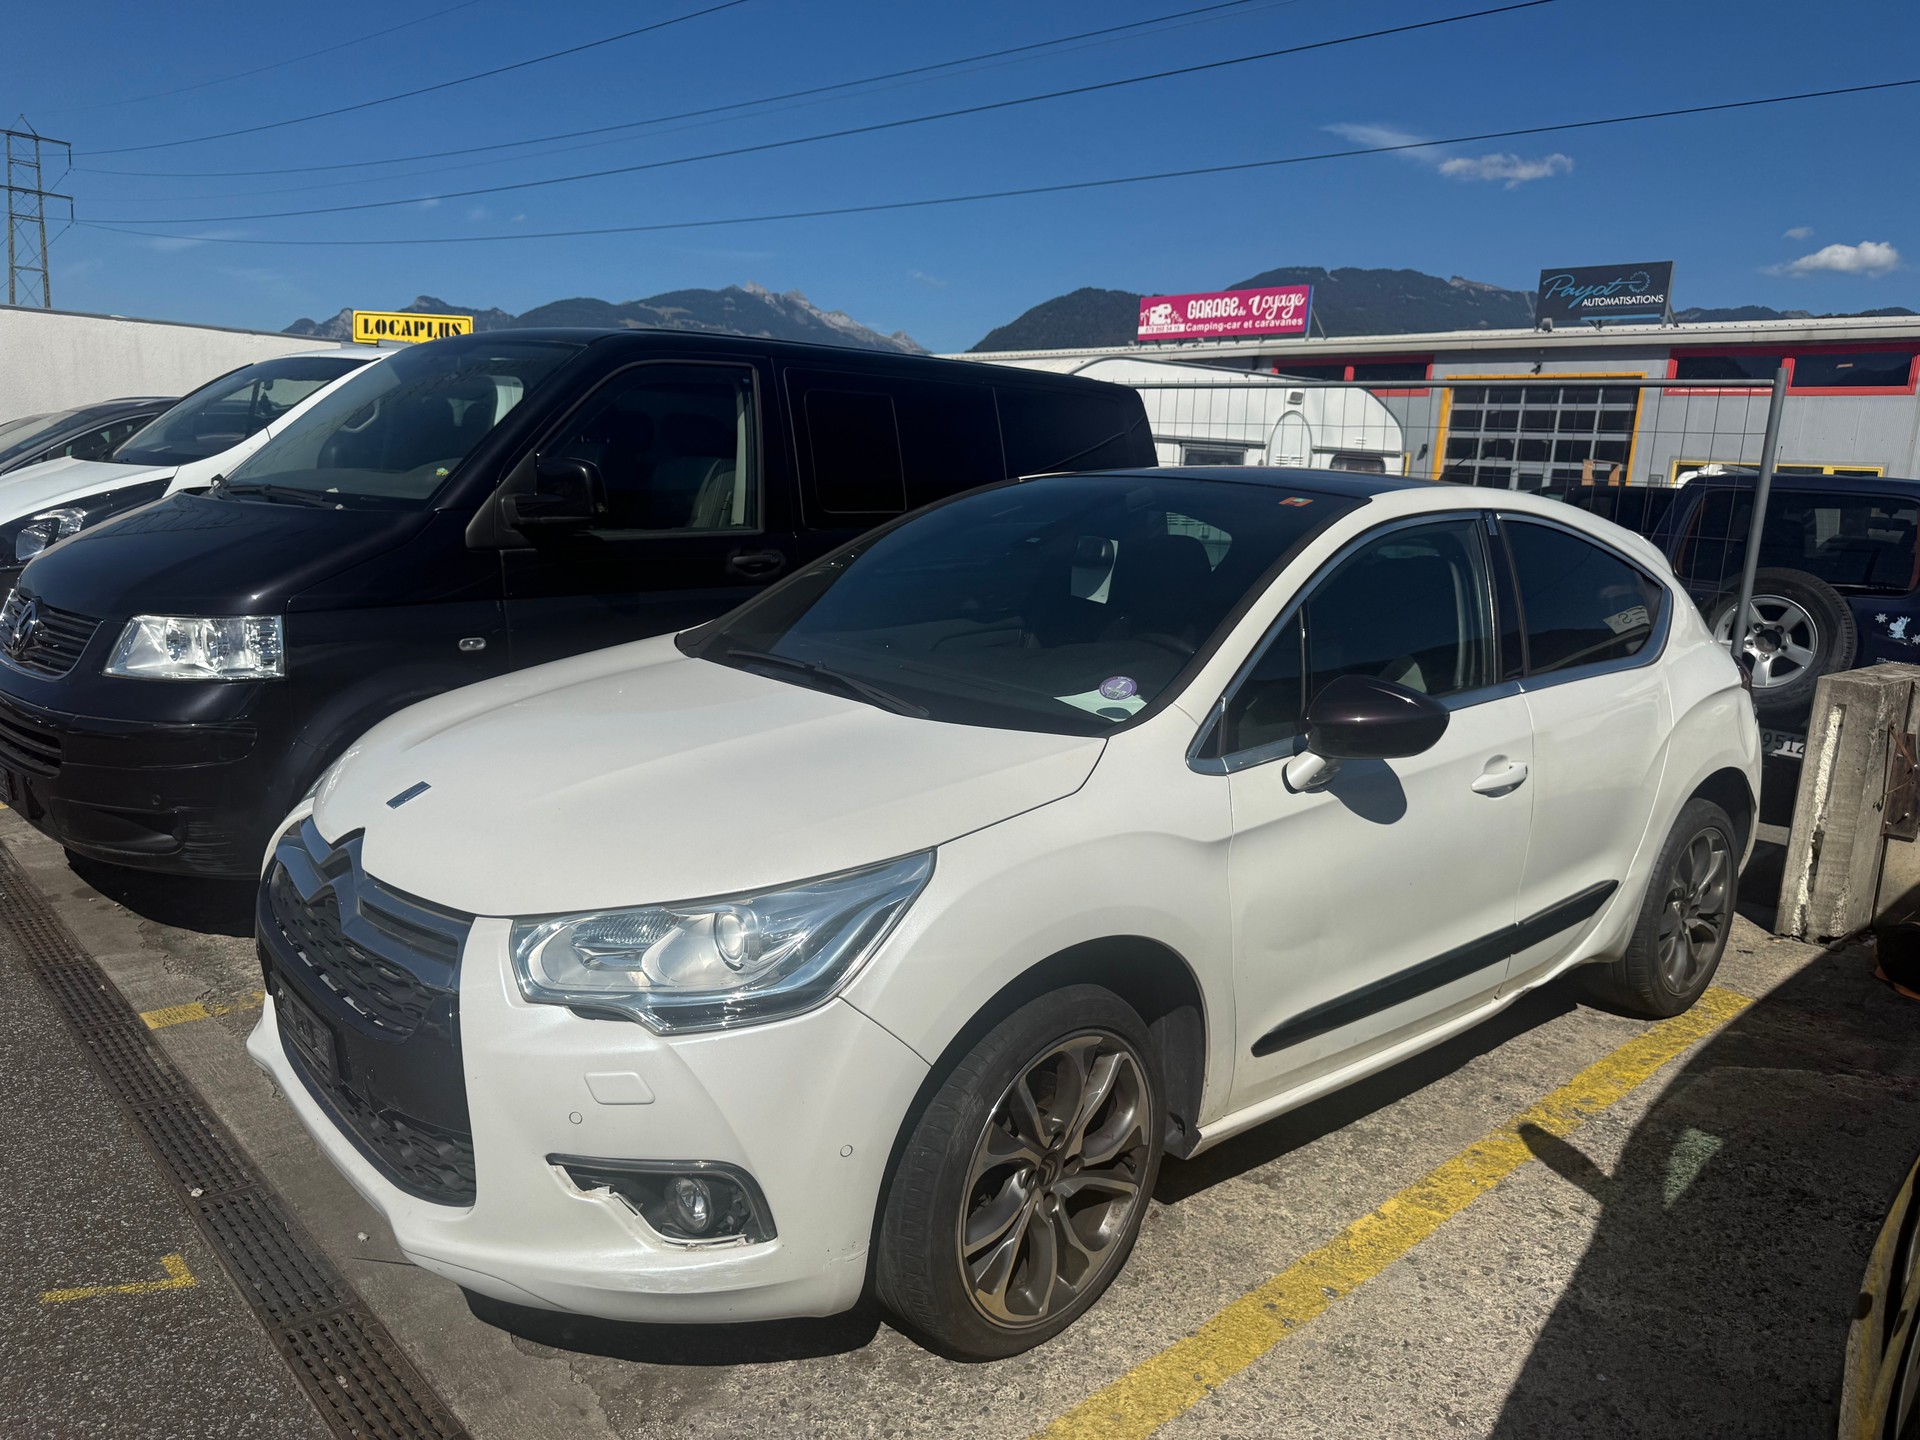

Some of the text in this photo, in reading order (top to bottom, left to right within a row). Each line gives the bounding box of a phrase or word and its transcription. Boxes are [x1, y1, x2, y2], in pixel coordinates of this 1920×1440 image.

[1543, 274, 1623, 309] Payot
[1581, 294, 1664, 306] AUTOMATISATIONS
[1187, 297, 1239, 319] GARAGE
[1248, 293, 1306, 320] Voyage
[363, 318, 462, 339] LOCAPLUS
[1185, 321, 1241, 333] Camping-car
[1243, 320, 1253, 329] et
[1254, 317, 1303, 329] caravanes
